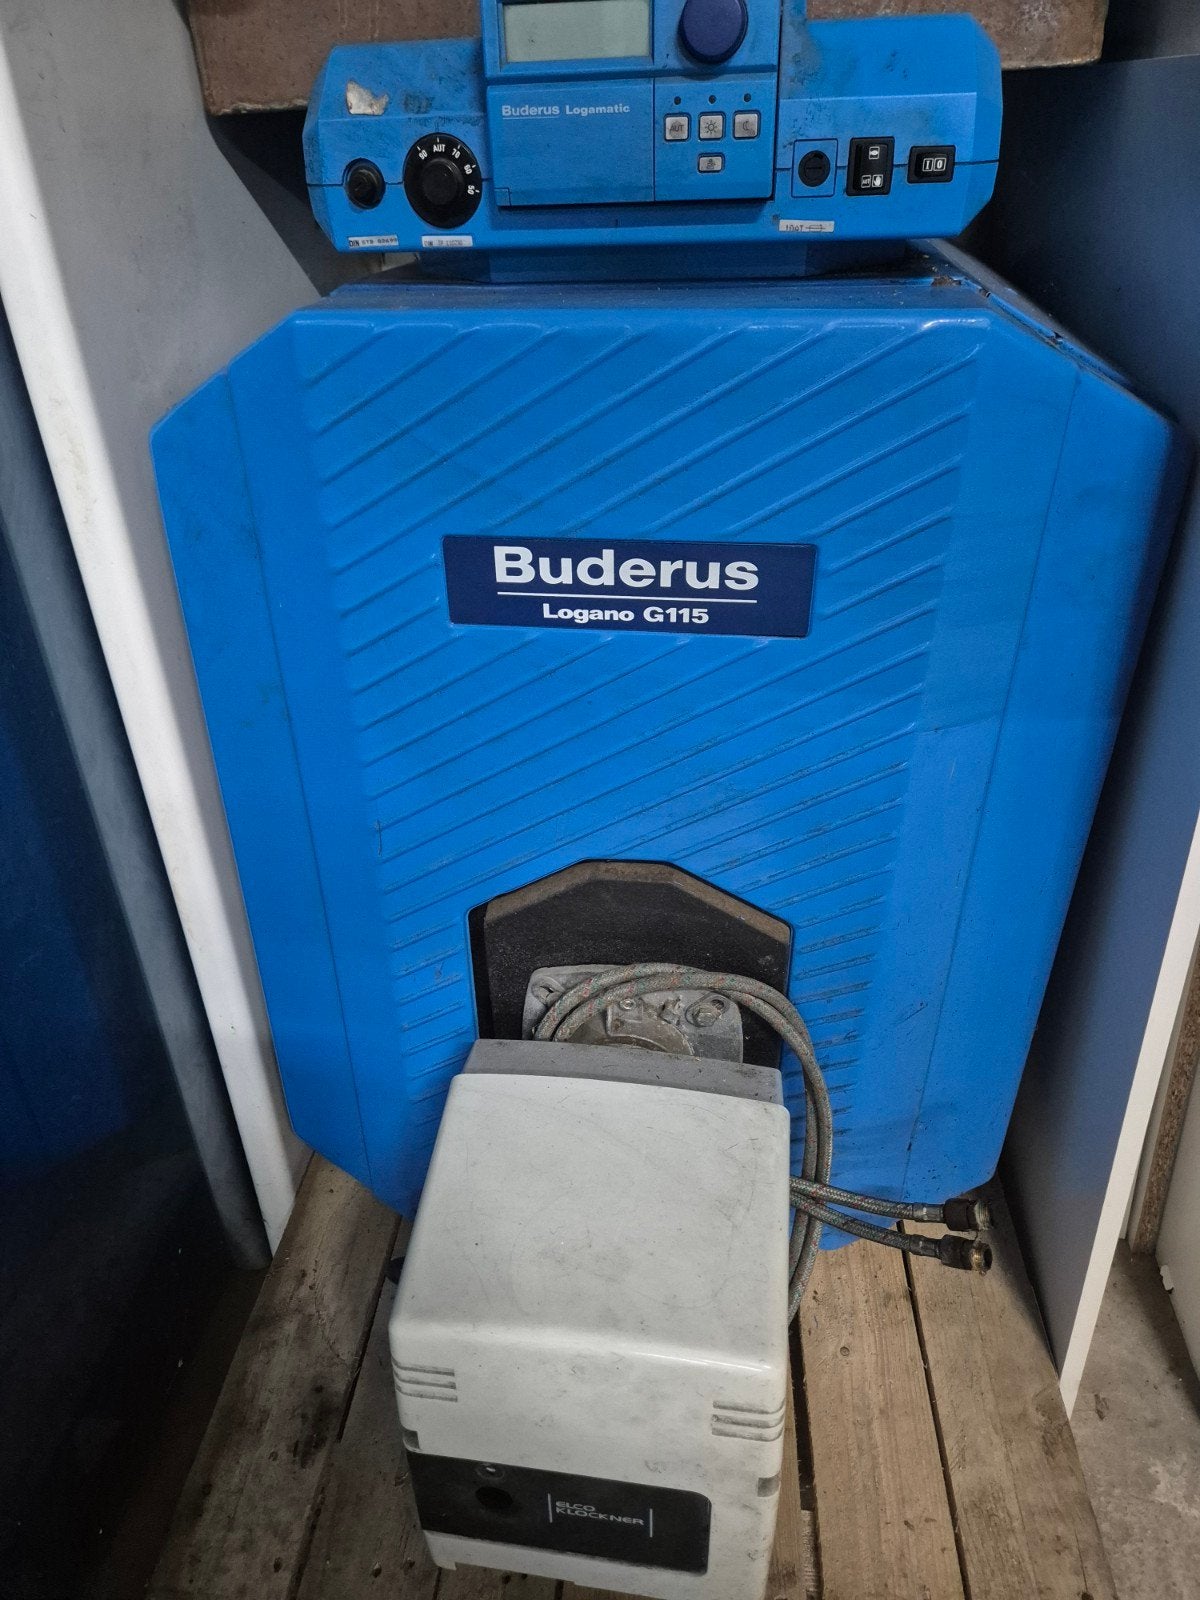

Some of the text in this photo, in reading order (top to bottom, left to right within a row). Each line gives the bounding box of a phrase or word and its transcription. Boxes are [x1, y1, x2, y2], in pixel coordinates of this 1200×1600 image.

[501, 103, 630, 117] Buderus Logamatic
[433, 144, 446, 152] AUT
[451, 148, 461, 159] 70
[467, 185, 475, 195] 50
[493, 545, 760, 591] Buderus
[542, 603, 709, 624] Logano G115
[555, 1501, 596, 1512] ELCO
